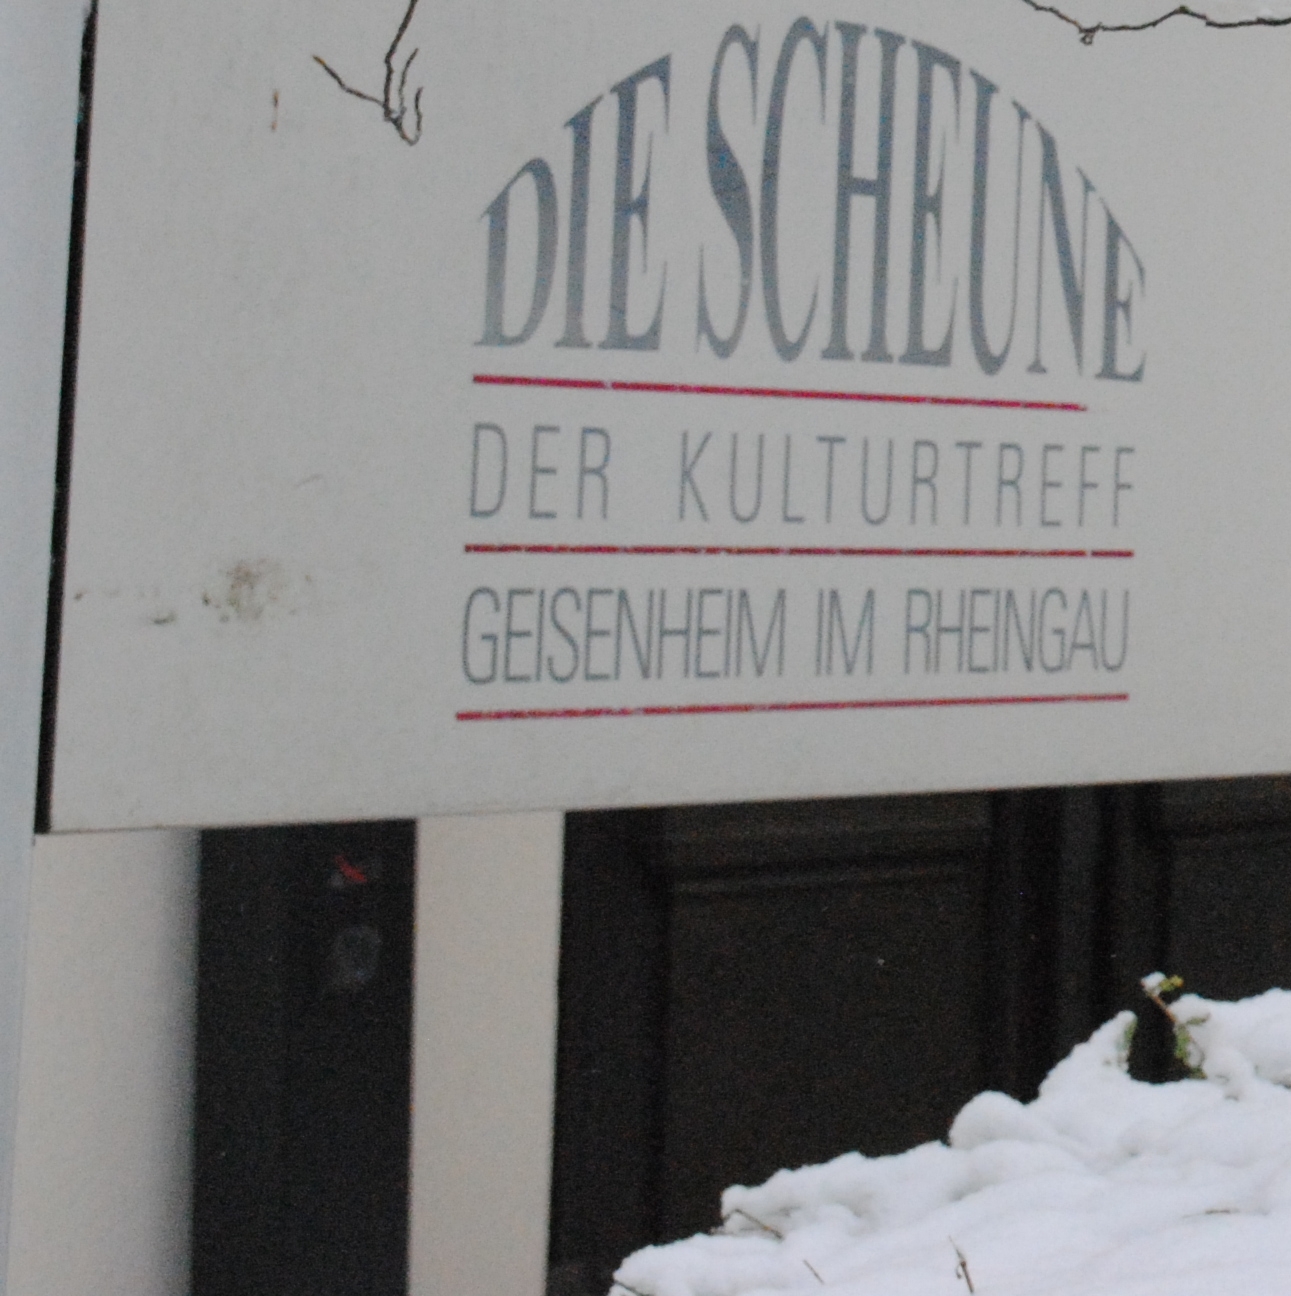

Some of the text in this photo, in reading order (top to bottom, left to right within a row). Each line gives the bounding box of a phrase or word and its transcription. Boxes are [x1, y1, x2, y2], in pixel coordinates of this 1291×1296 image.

[473, 15, 1148, 383] DIE SCHEUNE
[467, 422, 1136, 528] DER KULTURTREFF
[460, 586, 1130, 685] GEISENHEIM IM RHEINGAU
